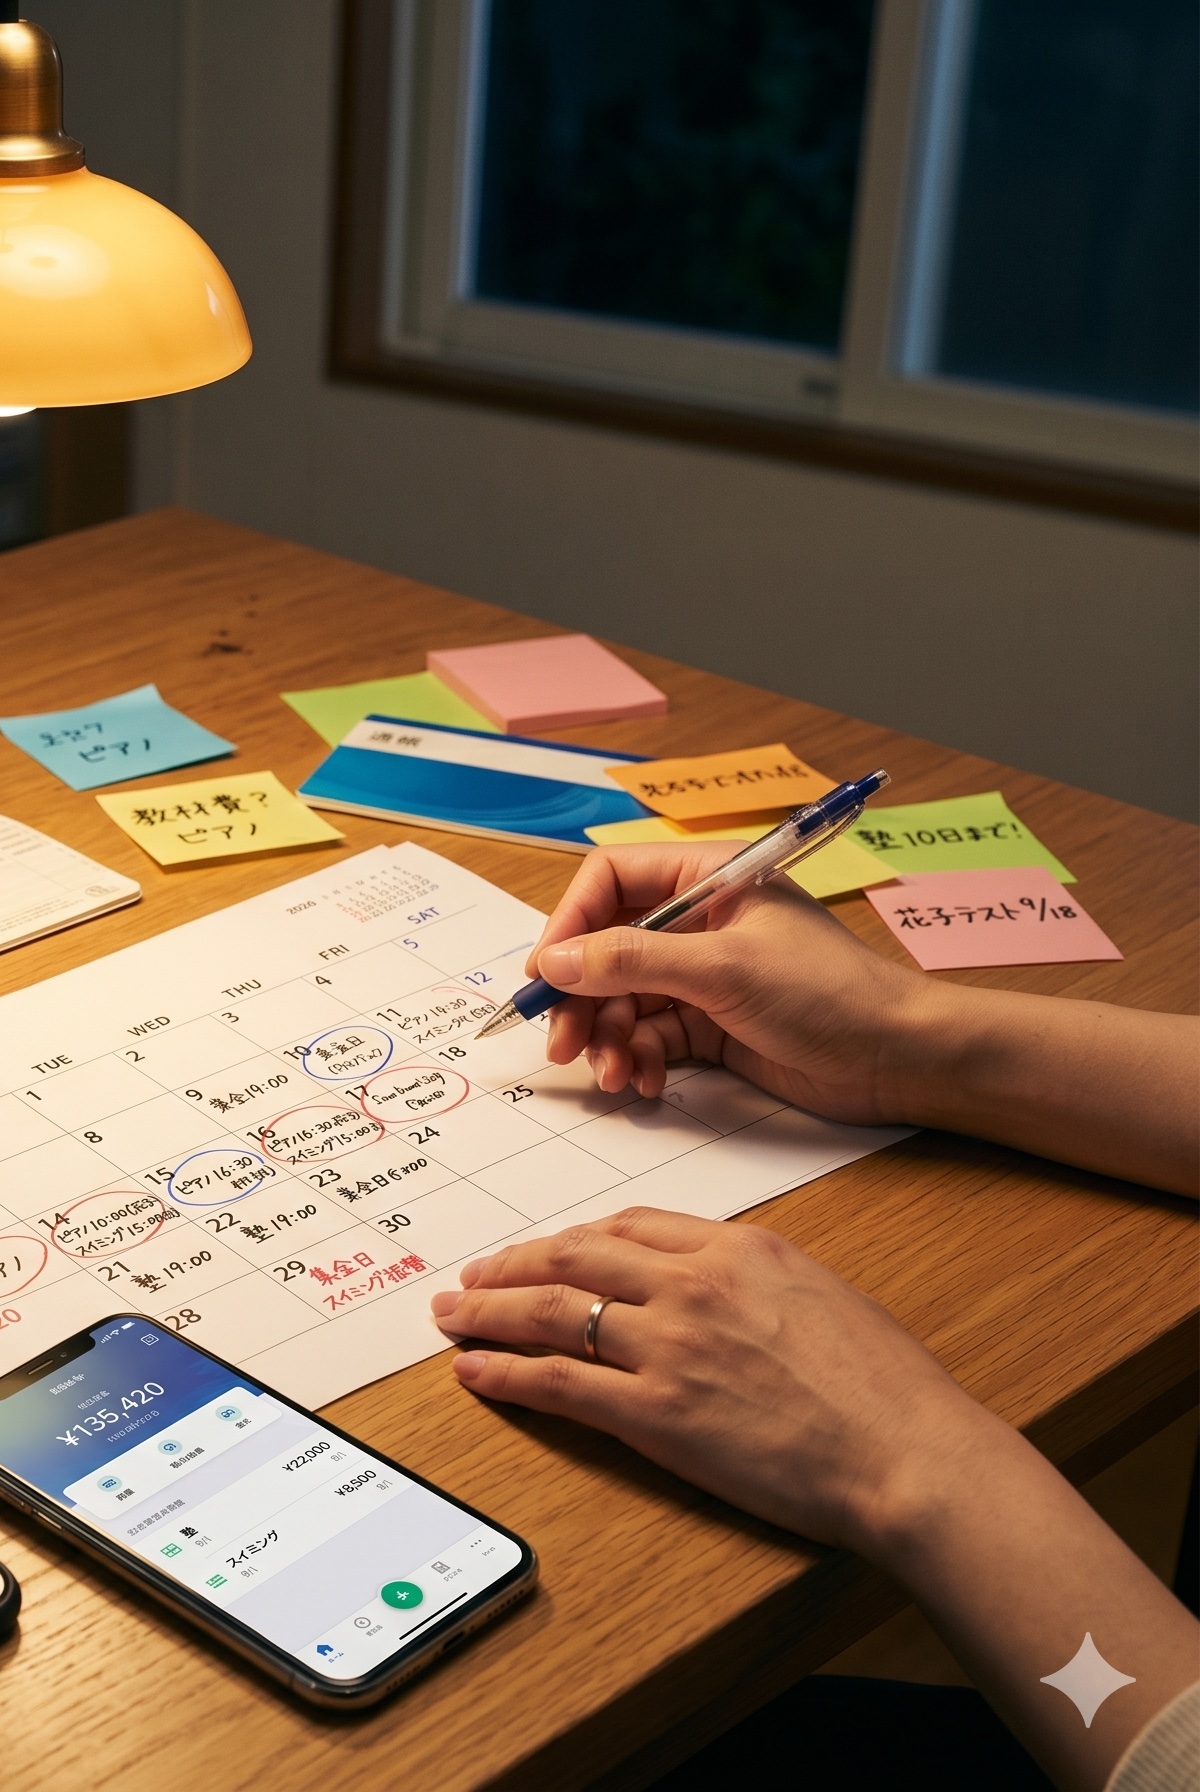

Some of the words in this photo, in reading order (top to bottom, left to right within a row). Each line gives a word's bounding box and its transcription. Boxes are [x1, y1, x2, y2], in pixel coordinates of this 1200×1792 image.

[178, 823, 258, 844] ピアノ
[407, 907, 440, 925] SAT
[318, 944, 350, 961] FRI
[403, 938, 419, 950] 5
[221, 978, 262, 999] THU
[315, 975, 332, 986] 4
[464, 971, 493, 987] 12
[221, 1011, 240, 1024] 3
[376, 1007, 403, 1025] 11
[127, 1016, 171, 1037] WED
[125, 1050, 145, 1063] 2
[283, 1045, 311, 1060] 10
[438, 1046, 467, 1062] 18
[31, 1054, 73, 1075] TUE
[26, 1090, 42, 1102] 1
[185, 1089, 203, 1102] 9
[345, 1084, 370, 1101] 17
[502, 1084, 535, 1103] 25
[83, 1130, 103, 1144] 8
[246, 1126, 276, 1142] 16
[408, 1126, 440, 1145] 24
[144, 1167, 175, 1185] 15
[308, 1168, 342, 1188] 23
[38, 1212, 71, 1231] 14
[205, 1212, 241, 1233] 22
[238, 1222, 275, 1244] 塾
[270, 1204, 317, 1232] 19:00
[378, 1214, 412, 1233] 30
[97, 1260, 131, 1282] 21
[130, 1272, 167, 1294] 塾
[162, 1250, 212, 1278] 19:00
[273, 1260, 306, 1282] 29
[309, 1252, 375, 1286] 集金日
[164, 1308, 202, 1332] 28
[55, 1382, 165, 1447] ¥135,420
[282, 1441, 331, 1472] ¥22,000
[225, 1529, 278, 1568] スイミング
[334, 1470, 377, 1496] ¥8,500
